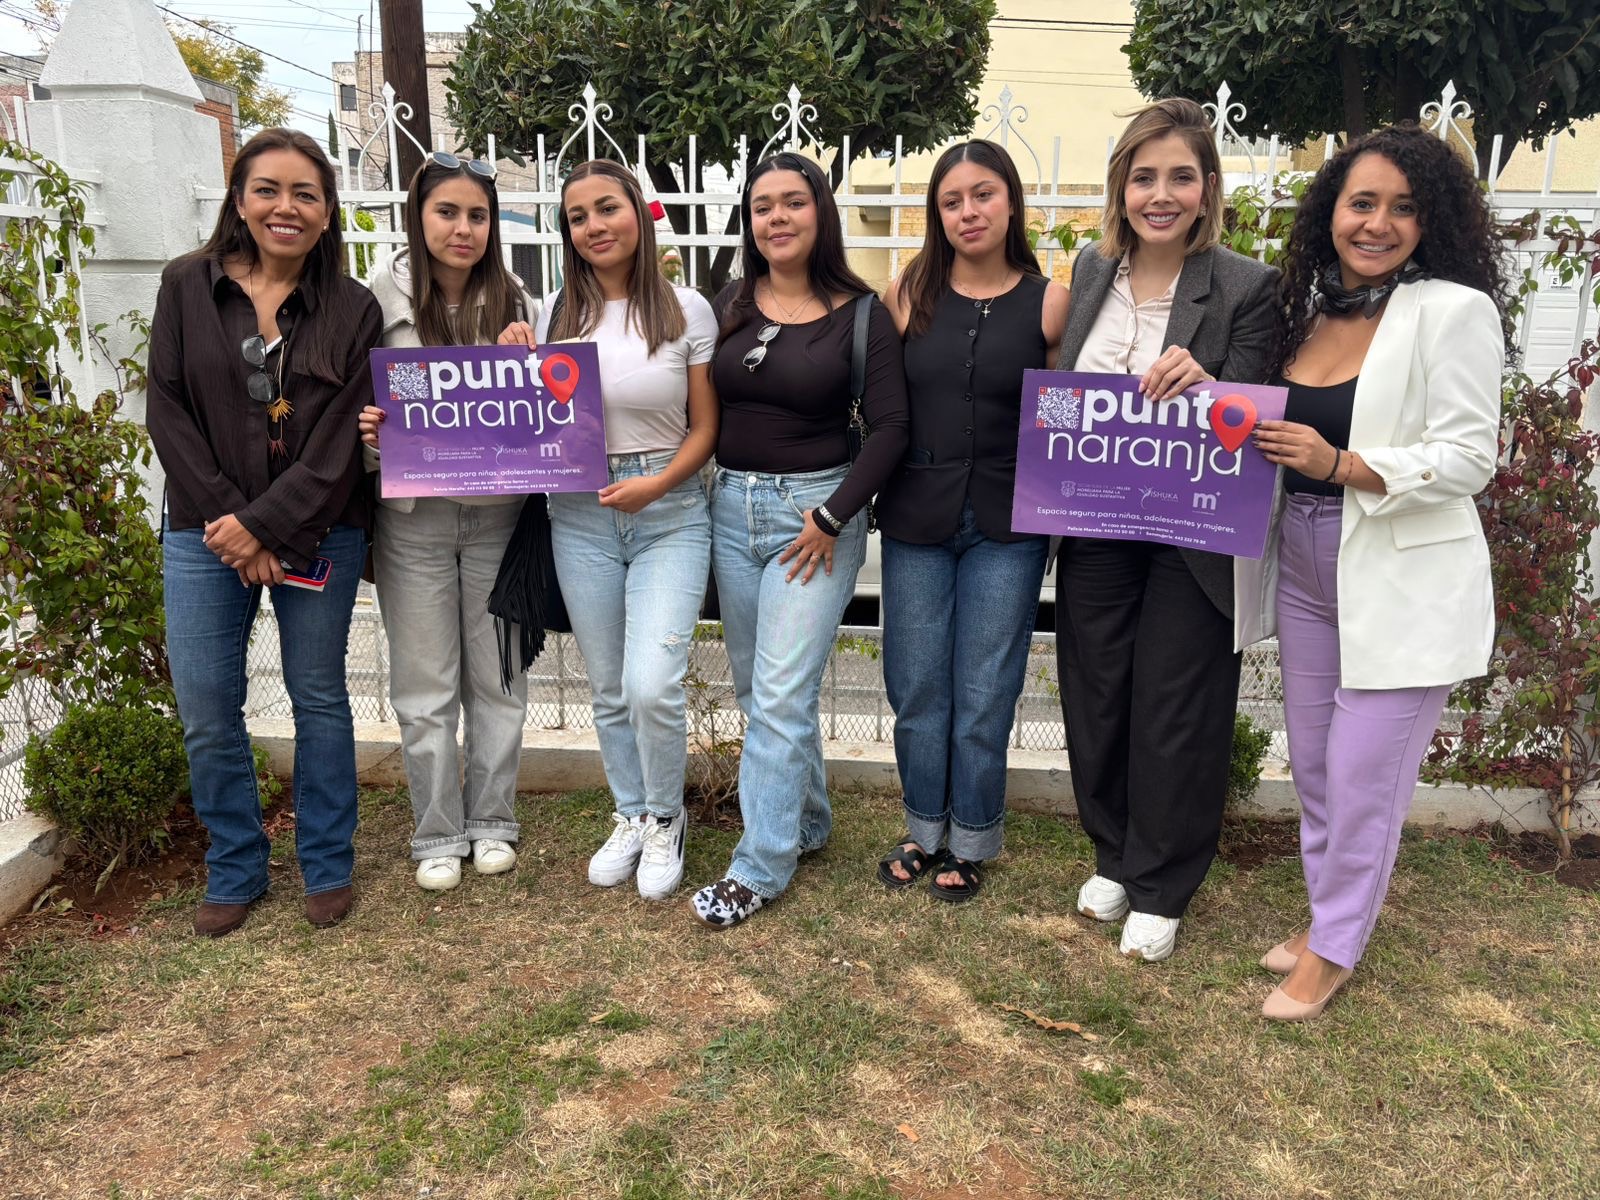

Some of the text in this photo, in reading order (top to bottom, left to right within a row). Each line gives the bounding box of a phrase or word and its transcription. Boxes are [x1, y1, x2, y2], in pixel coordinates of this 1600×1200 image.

[404, 390, 575, 435] naranja
[404, 471, 432, 480] Espacio
[478, 469, 499, 477] niñas,
[501, 468, 546, 476] adolescentes
[553, 466, 583, 475] mujeres.
[1047, 432, 1243, 482] naranja
[1037, 506, 1067, 515] Espacio
[1069, 509, 1096, 518] seguro
[1119, 511, 1142, 521] niñas,
[1144, 514, 1195, 527] adolescentes
[1203, 522, 1237, 534] mujeres.
